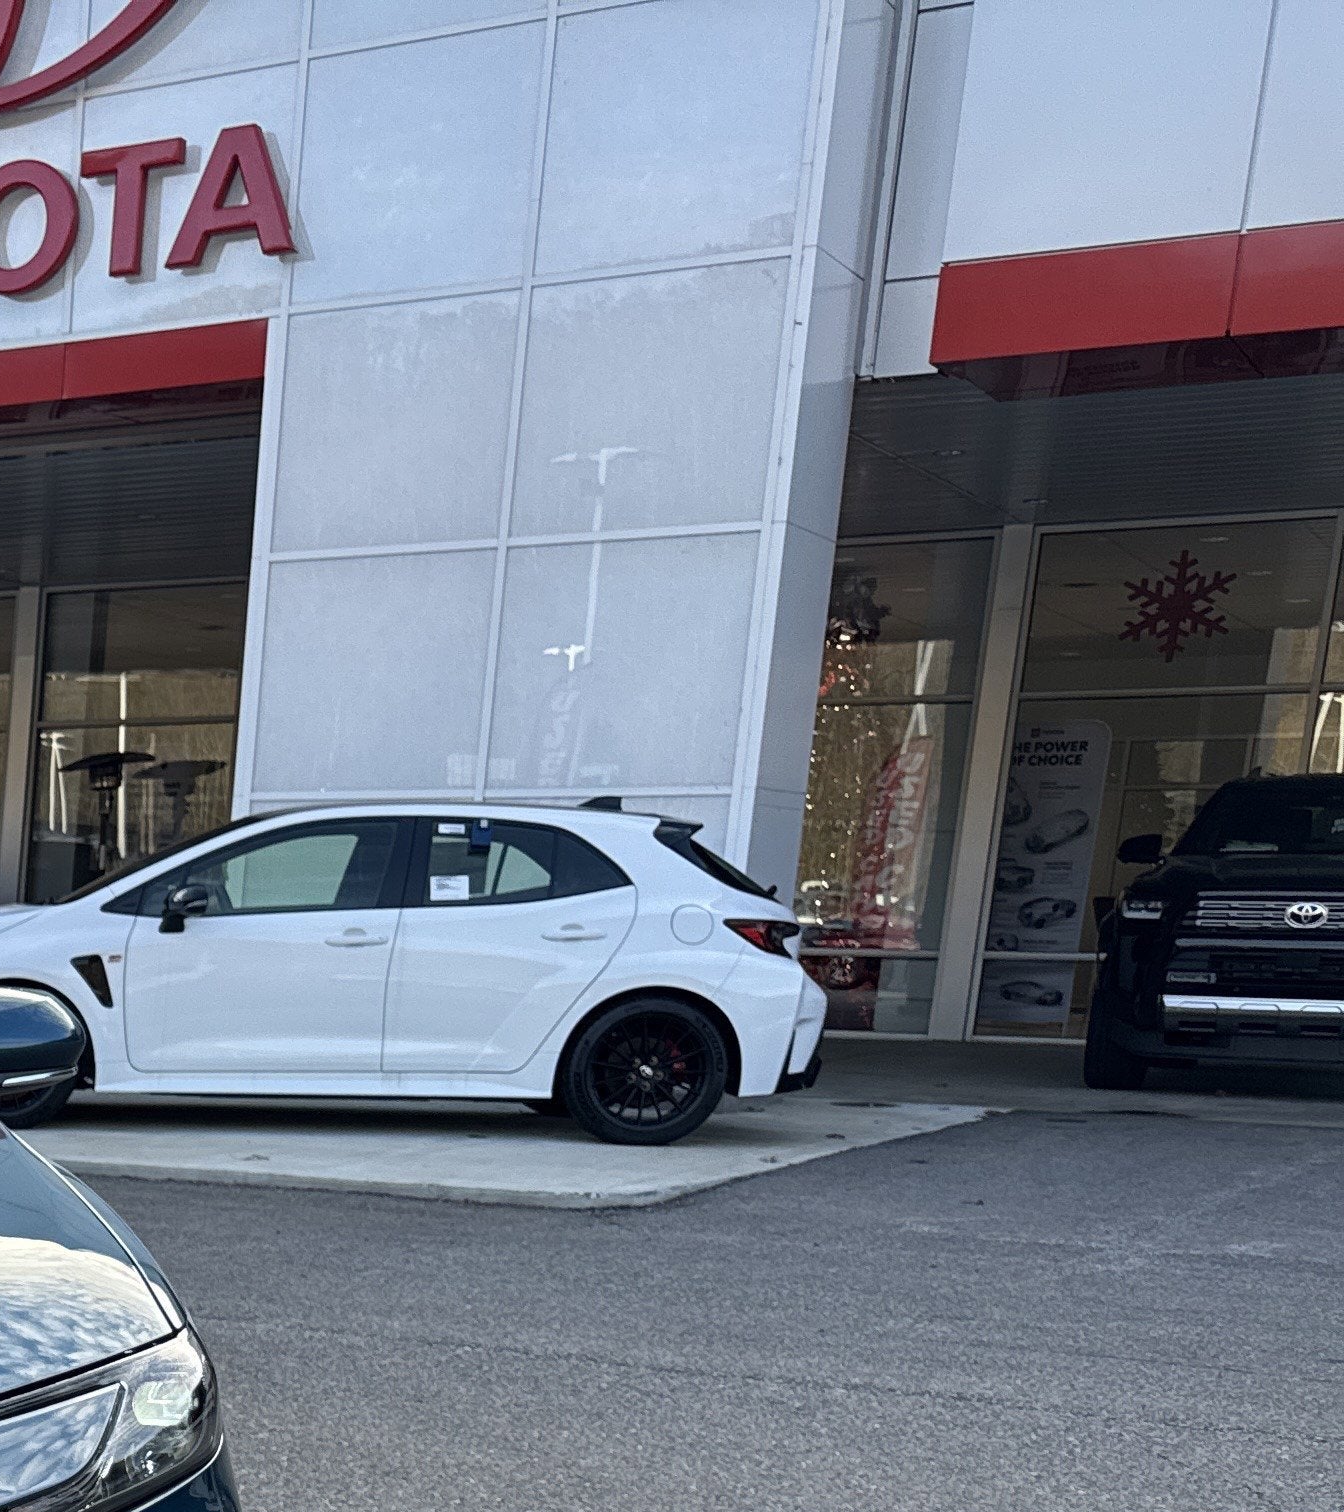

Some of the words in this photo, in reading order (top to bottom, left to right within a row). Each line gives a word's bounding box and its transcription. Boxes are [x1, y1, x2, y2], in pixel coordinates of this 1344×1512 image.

[1014, 741, 1031, 753] HE
[1034, 740, 1088, 753] POWER
[1028, 754, 1083, 767] CHOICE
